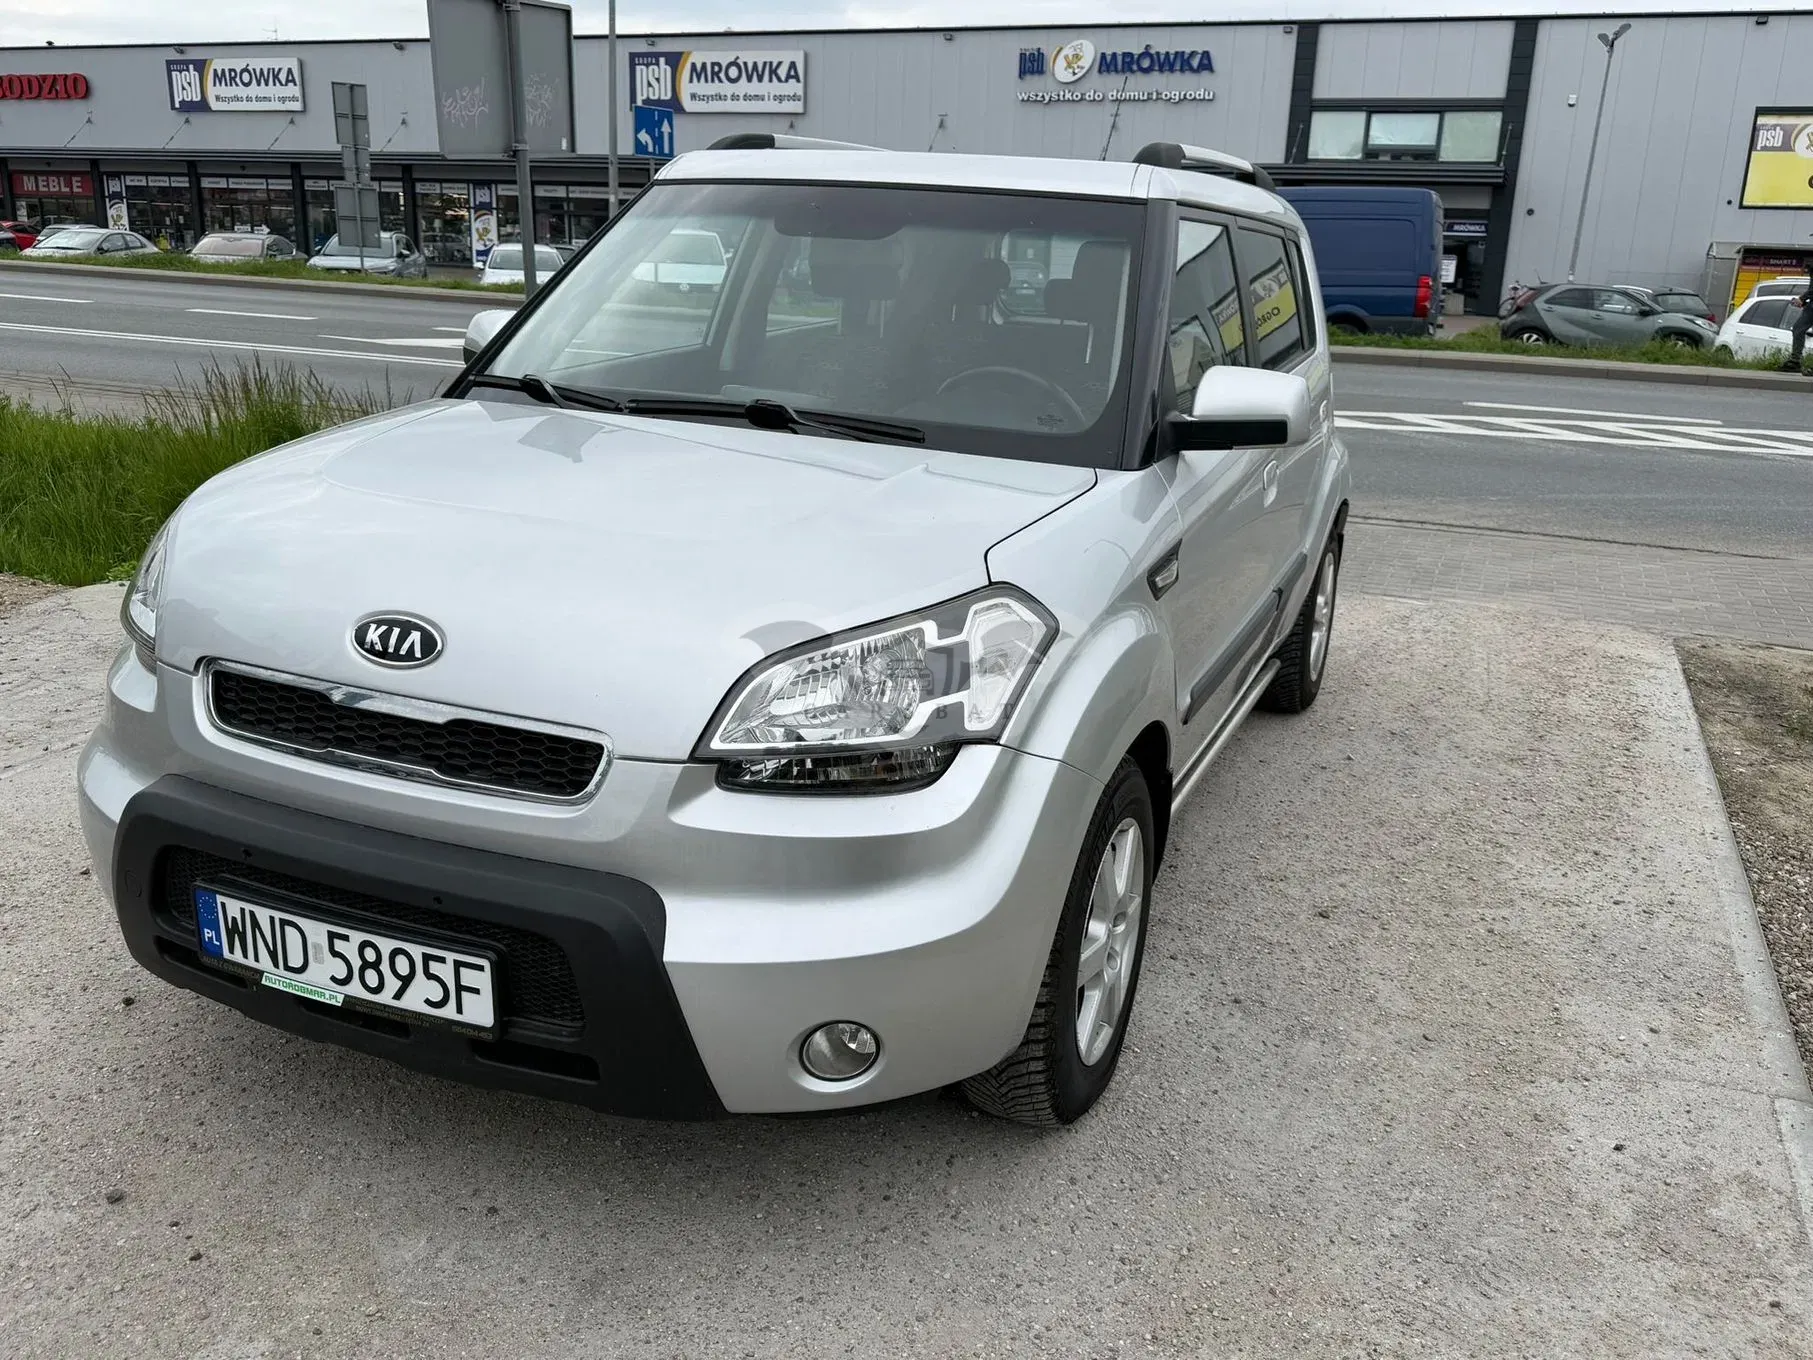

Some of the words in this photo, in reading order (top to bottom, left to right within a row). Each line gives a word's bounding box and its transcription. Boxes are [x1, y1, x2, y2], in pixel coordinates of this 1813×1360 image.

[1019, 47, 1045, 80] psb
[1098, 44, 1215, 74] MRÓWKA
[0, 73, 88, 100] ODZIO
[171, 64, 202, 109] psb
[212, 63, 298, 88] MRÓWKA
[635, 57, 672, 106] psb
[688, 56, 801, 84] MRÓWKA
[214, 94, 244, 104] Wszystko
[245, 94, 254, 102] do
[689, 92, 728, 104] Wszystko
[730, 92, 740, 102] do
[742, 92, 766, 102] domu
[772, 92, 802, 104] ogrodu
[1017, 89, 1081, 104] wszystko
[1086, 89, 1103, 101] do
[1108, 89, 1148, 101] domu
[1162, 88, 1214, 102] ogrodu
[1756, 126, 1784, 150] psb
[23, 175, 83, 193] MEBLE
[364, 623, 422, 659] KIA
[204, 928, 220, 946] PL
[220, 900, 309, 975] WND
[326, 929, 485, 1015] 5895F
